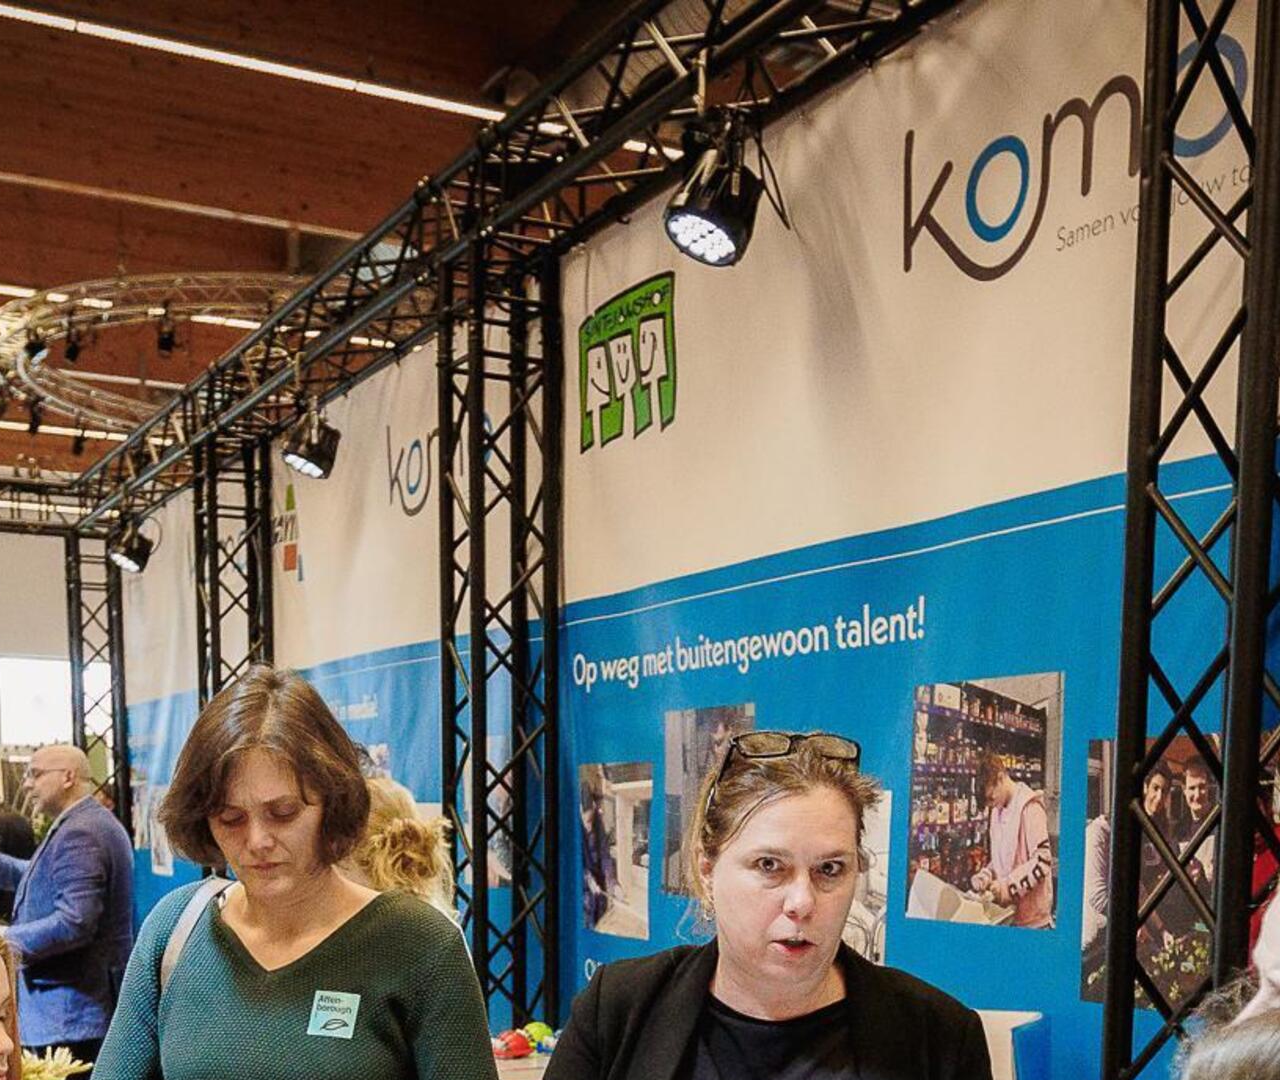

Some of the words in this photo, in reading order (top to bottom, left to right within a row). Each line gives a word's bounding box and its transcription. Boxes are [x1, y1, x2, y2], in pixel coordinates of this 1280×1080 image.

[1056, 214, 1116, 252] Samen
[573, 653, 597, 693] Op
[600, 653, 639, 689] weg
[642, 649, 675, 678] met
[675, 624, 830, 674] buitengewoon
[834, 595, 926, 649] talent!
